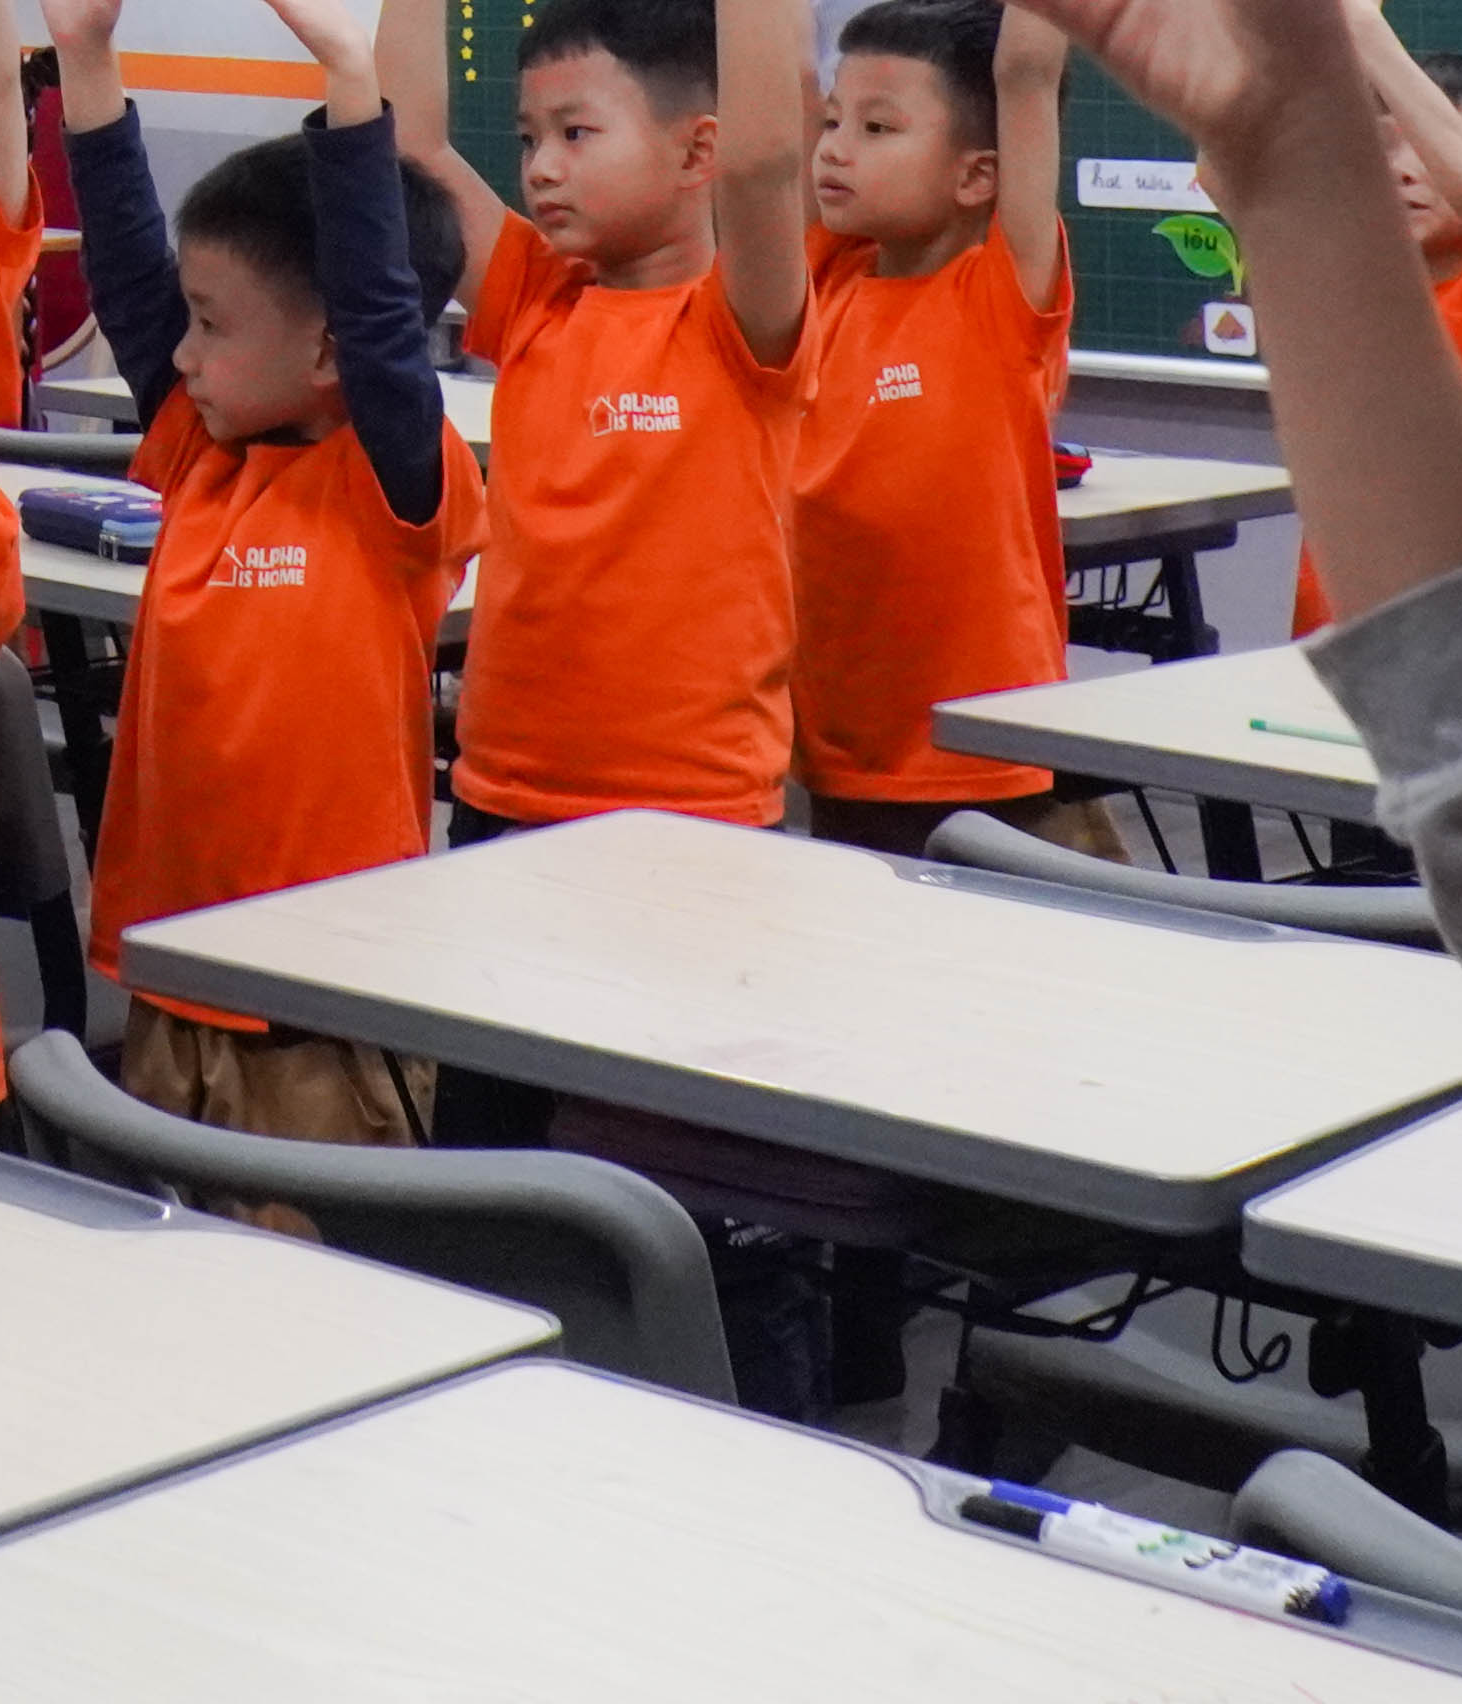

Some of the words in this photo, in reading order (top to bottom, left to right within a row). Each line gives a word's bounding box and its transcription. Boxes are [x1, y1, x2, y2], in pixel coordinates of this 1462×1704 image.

[875, 362, 921, 386] LPHA
[619, 392, 679, 415] ALPHA
[613, 414, 628, 432] IS
[632, 414, 682, 433] HOME
[246, 545, 307, 569] ALPHA
[238, 569, 254, 588] IS
[258, 567, 305, 588] HOME
